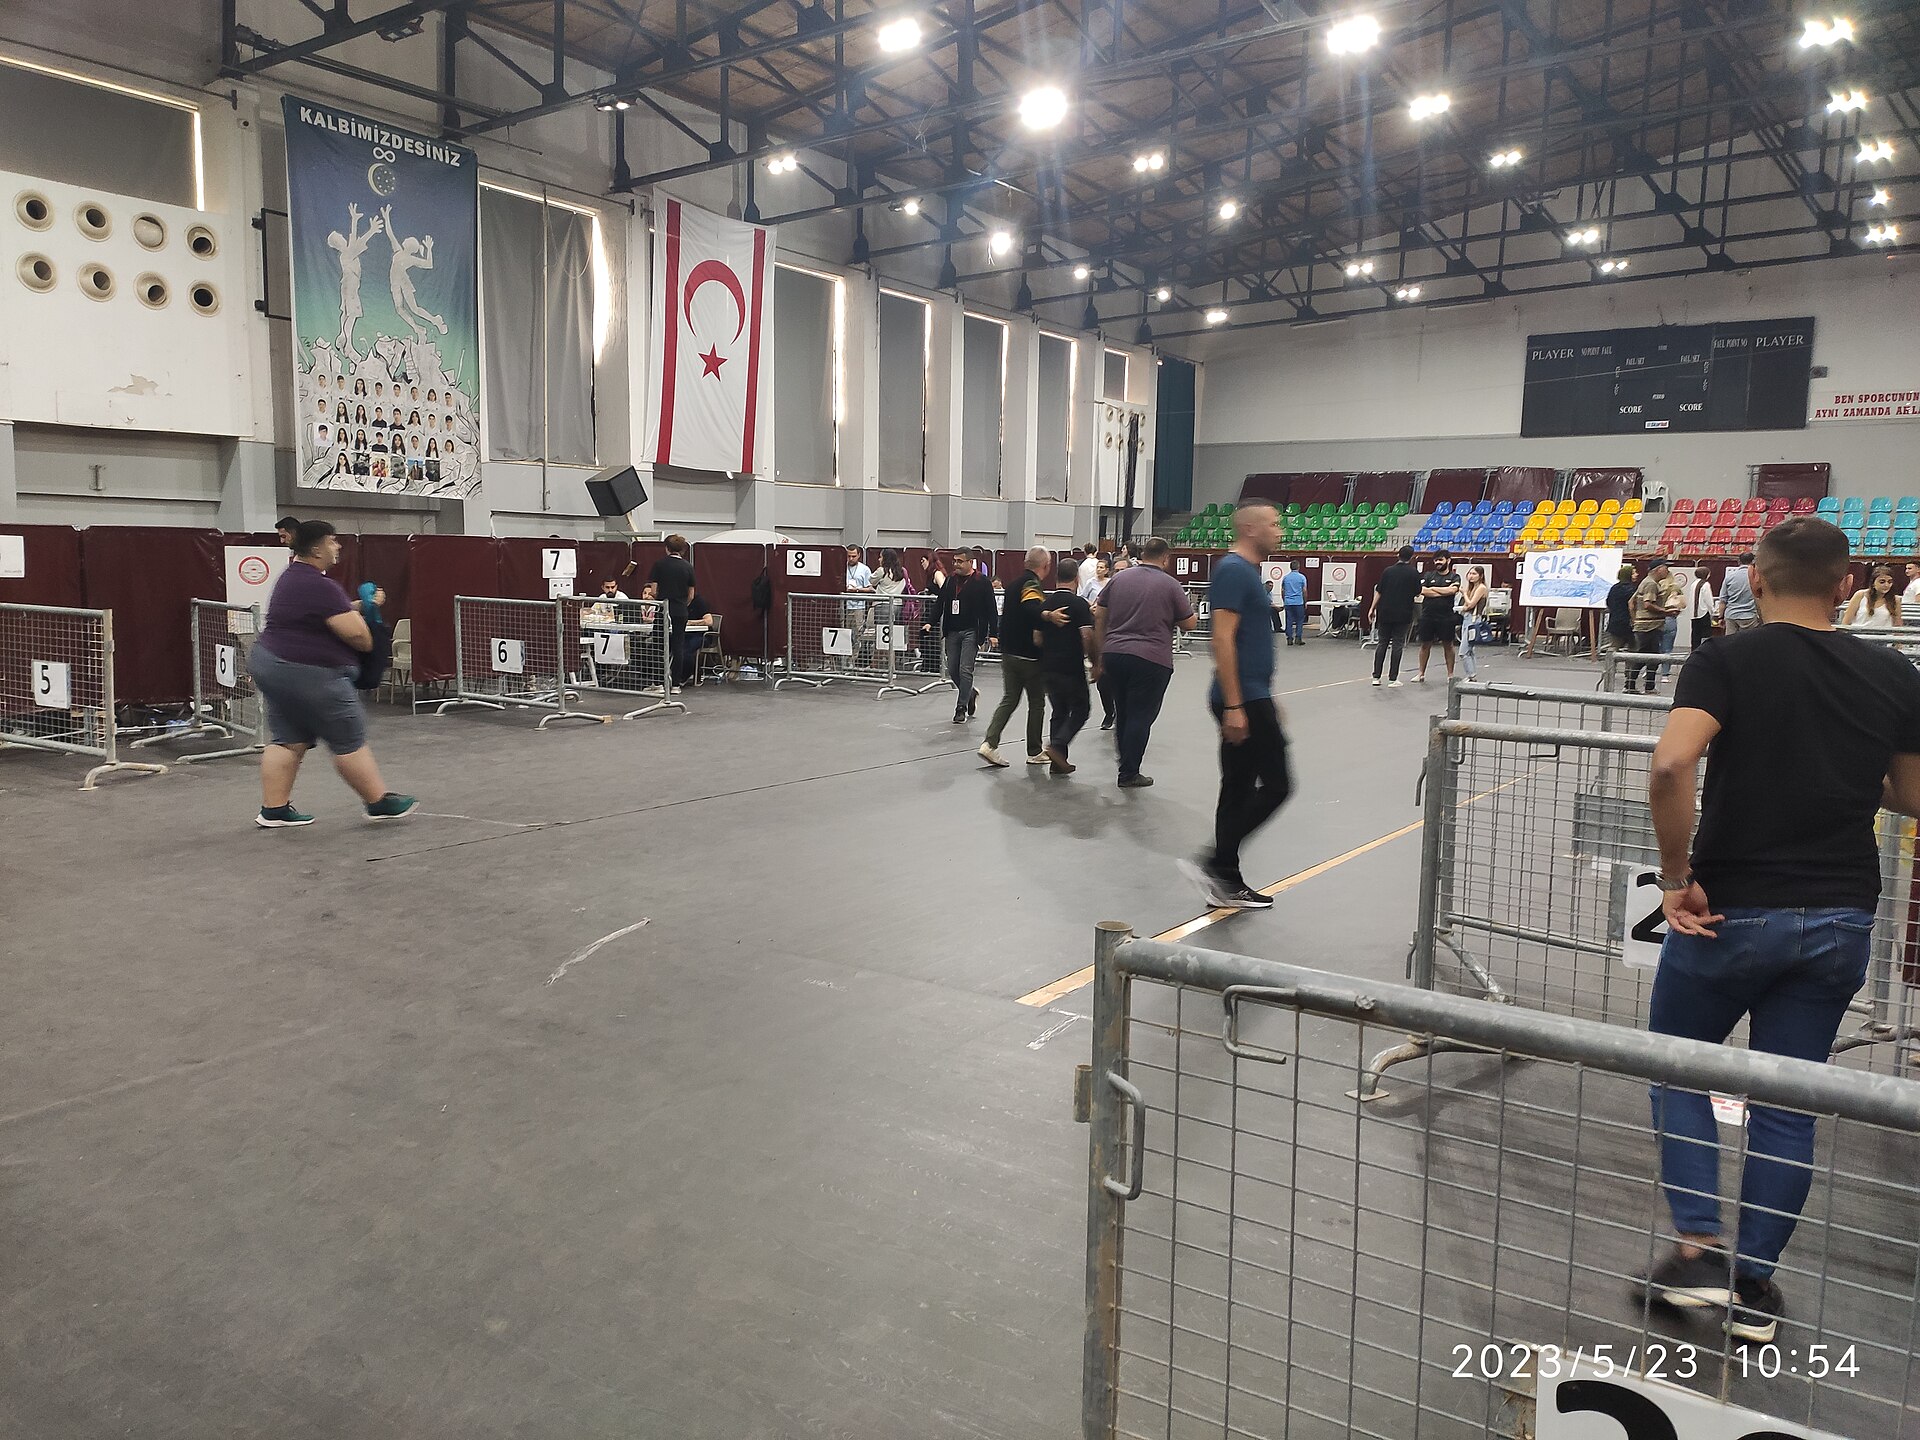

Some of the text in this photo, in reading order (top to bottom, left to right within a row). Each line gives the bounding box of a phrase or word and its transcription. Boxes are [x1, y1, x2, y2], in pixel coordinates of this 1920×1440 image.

[300, 106, 461, 167] KALBİMİZDESİNİZ
[1755, 335, 1804, 348] PLAYER
[1531, 349, 1574, 361] PLAYER
[1834, 392, 1920, 404] BEN SPORCUNUN
[1619, 405, 1642, 414] SCORE
[1679, 402, 1703, 412] SCORE
[1815, 409, 1839, 418] AYNI
[1843, 407, 1891, 417] ZAMANDA
[550, 550, 560, 571] 7
[794, 552, 805, 569] 8
[1533, 553, 1599, 579] ÇIKIŞ
[828, 630, 838, 648] 7
[882, 626, 890, 643] 8
[498, 641, 507, 663] 6
[600, 634, 610, 655] 7
[219, 647, 227, 675] 6
[40, 664, 51, 695] 5
